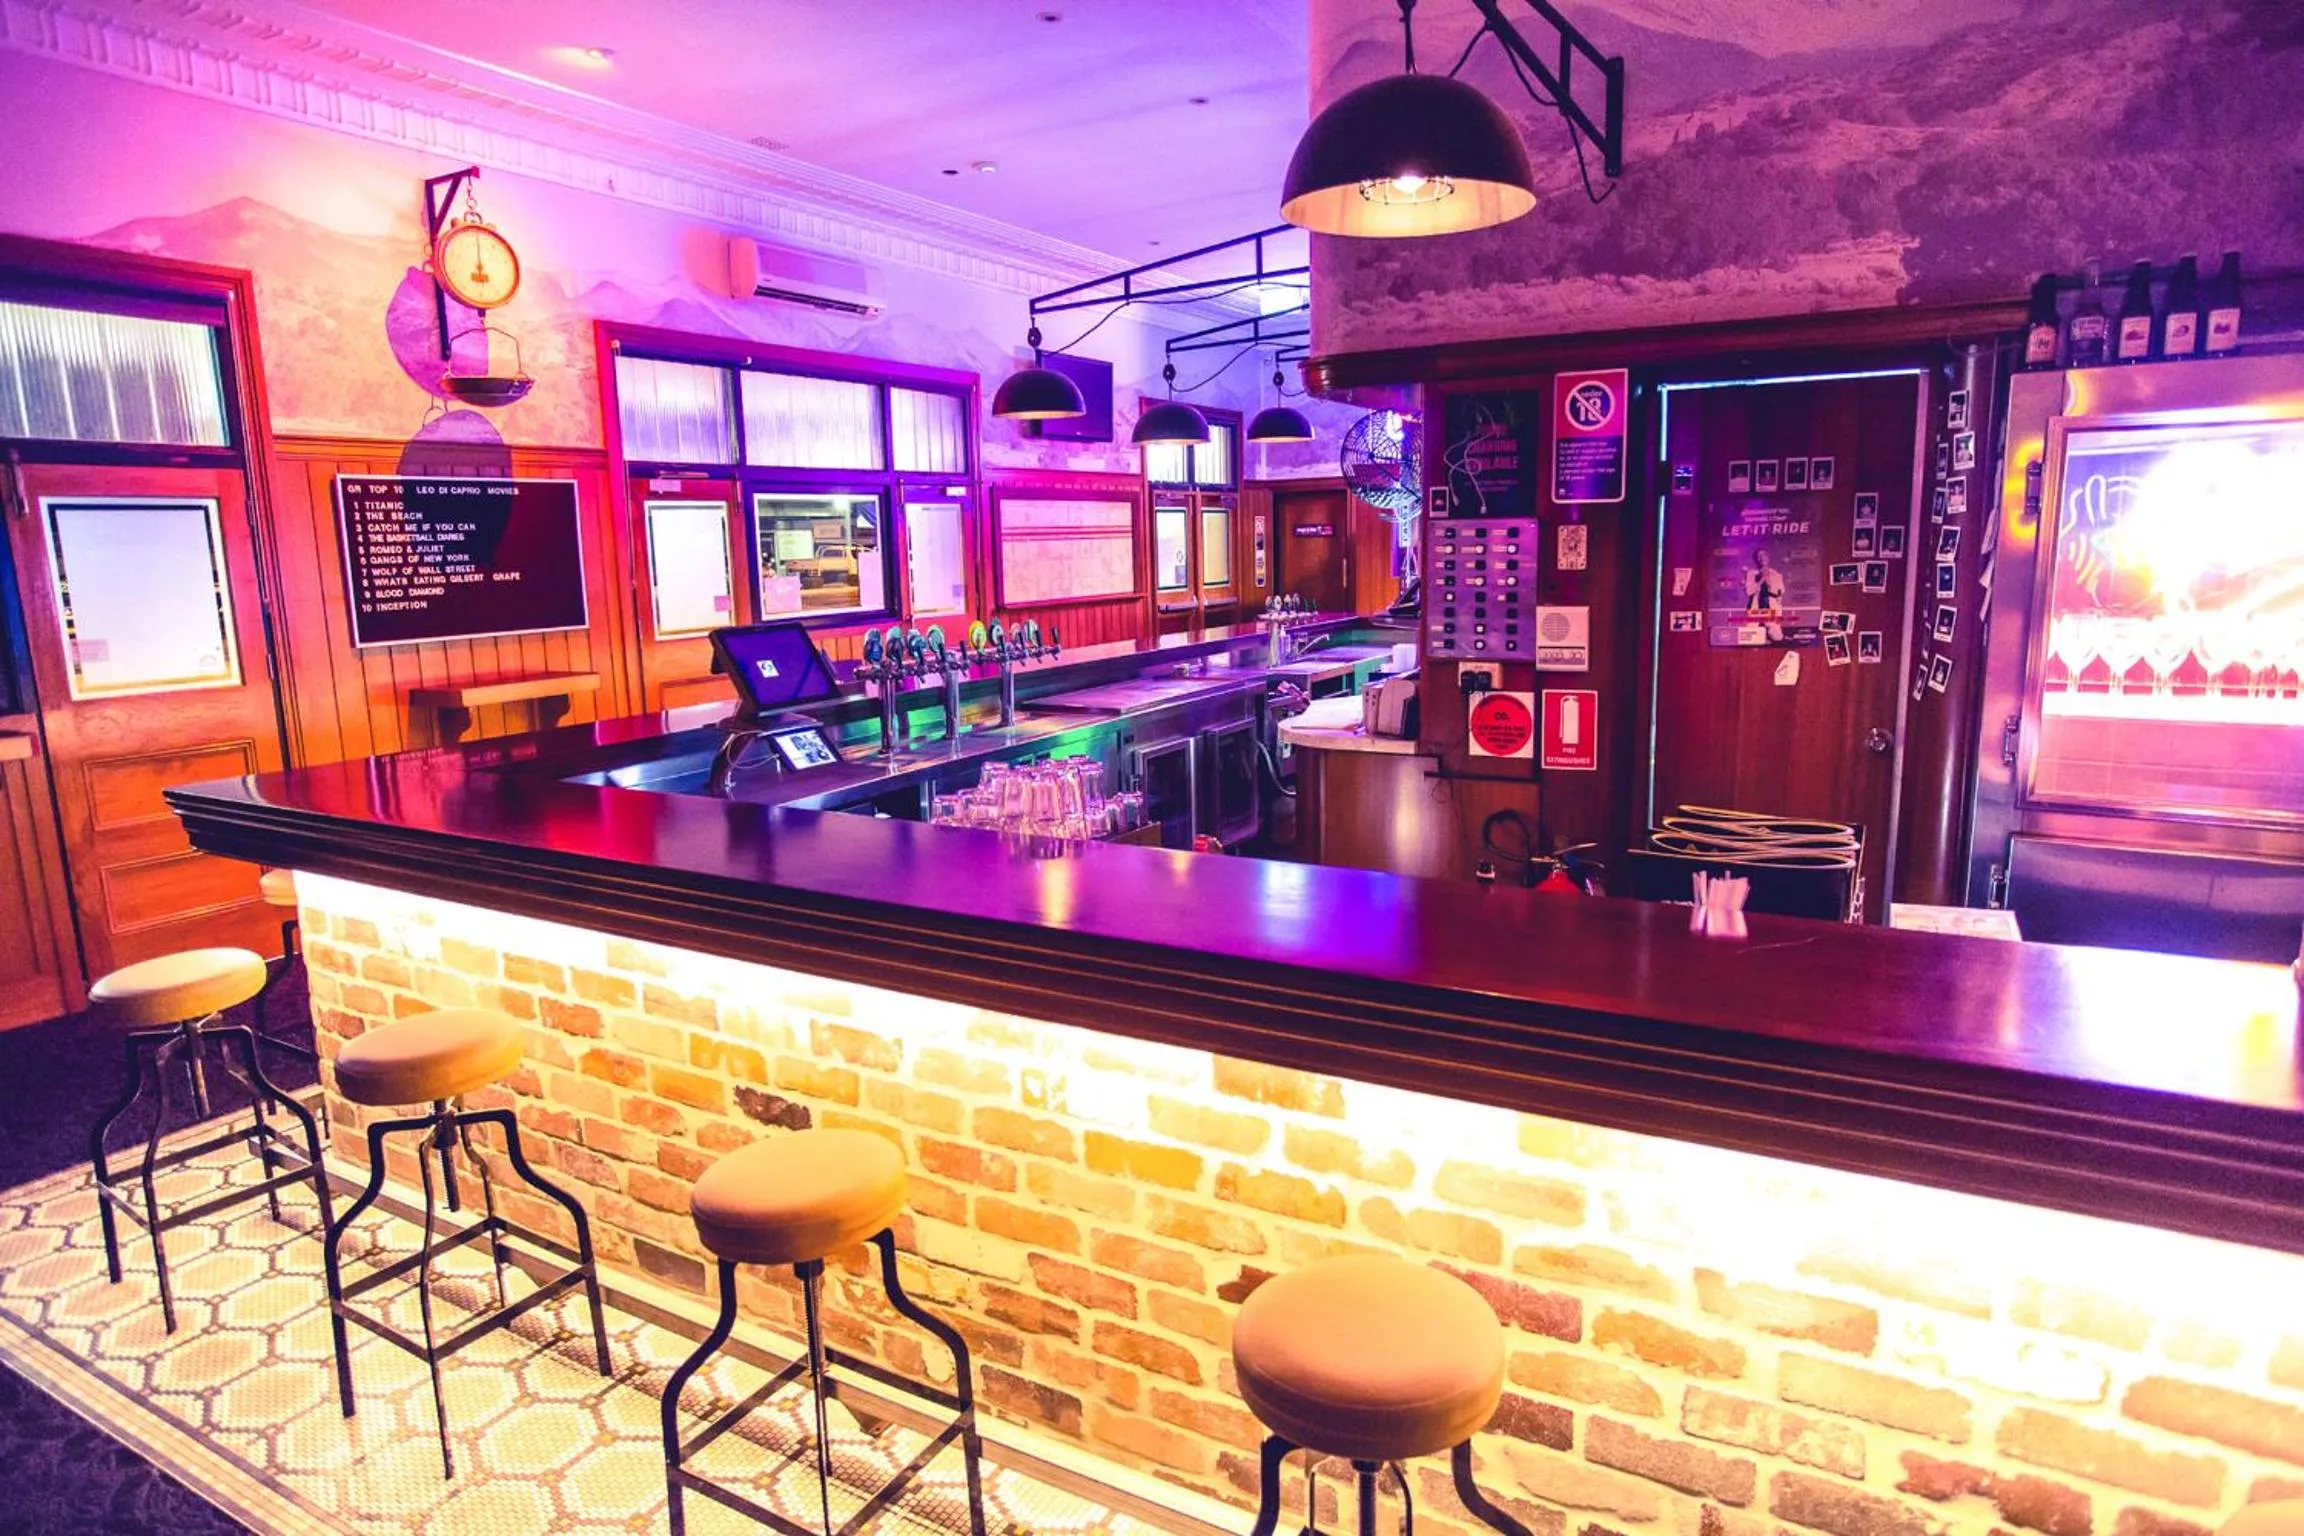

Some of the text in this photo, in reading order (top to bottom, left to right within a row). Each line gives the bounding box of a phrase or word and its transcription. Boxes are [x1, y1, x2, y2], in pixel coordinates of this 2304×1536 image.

[1576, 398, 1601, 422] 18
[368, 485, 388, 493] TOP
[393, 485, 405, 494] 10
[415, 486, 435, 494] LEO
[450, 486, 481, 495] CAPRIO
[487, 487, 520, 495] MOVIES
[353, 501, 405, 510] 1 TITANIC
[354, 512, 423, 520] 2 THE BEACH
[355, 523, 476, 532] 3 CATCH ME IF YOU CAN
[1722, 522, 1810, 536] LET IT RIDE
[357, 533, 465, 543] 4 THE BASKETBALL DIARIES
[358, 545, 445, 555] 5 ROMEO & JULIET
[360, 554, 470, 565] 6 GANGS OF NEW YORK
[361, 564, 476, 577] 7 WOLF OF WALL STREET
[362, 572, 521, 587] 8 WHATS EATING GILBERT GRAPE
[364, 587, 445, 598] 9 BLOOD DIAMOND
[361, 601, 428, 612] 10 INCEPTION
